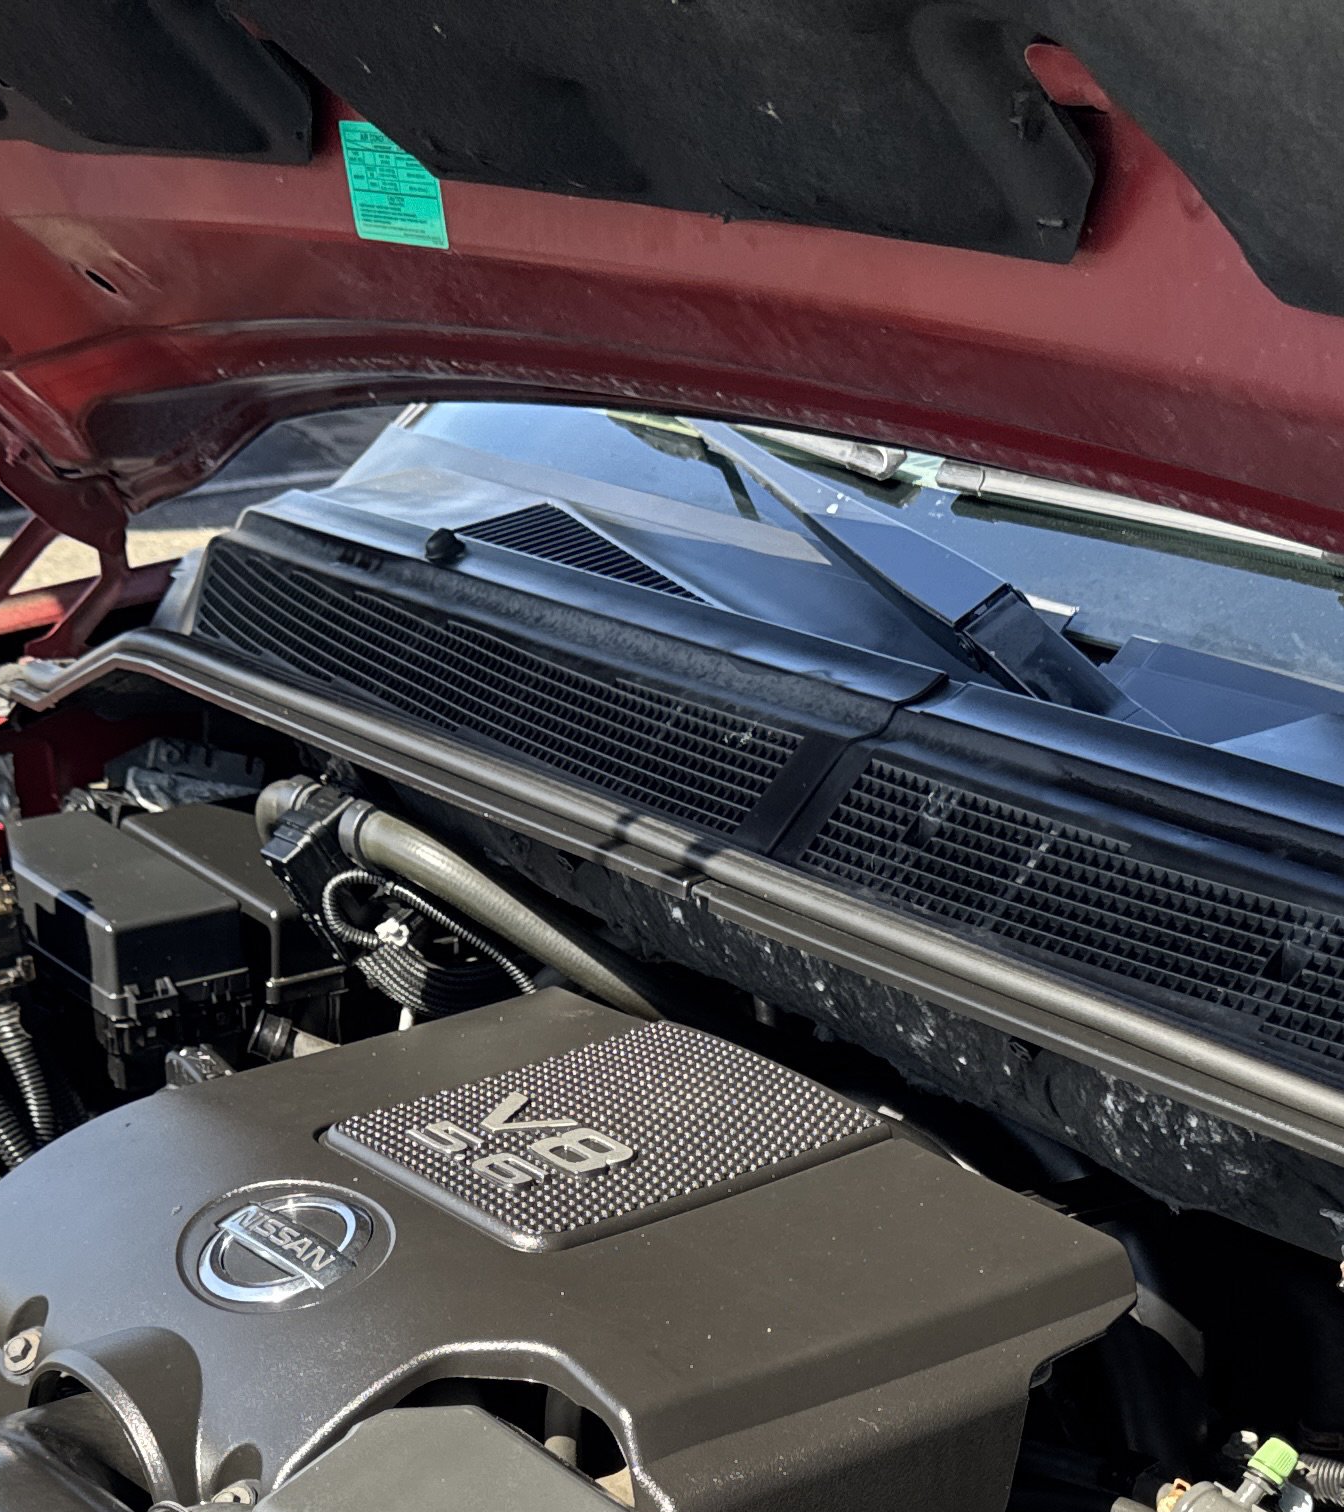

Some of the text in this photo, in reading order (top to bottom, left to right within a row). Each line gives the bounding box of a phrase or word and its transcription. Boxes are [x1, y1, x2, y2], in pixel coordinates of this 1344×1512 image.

[406, 1120, 549, 1190] 5.6
[479, 1091, 635, 1176] V8
[235, 1208, 336, 1271] NISSAN
